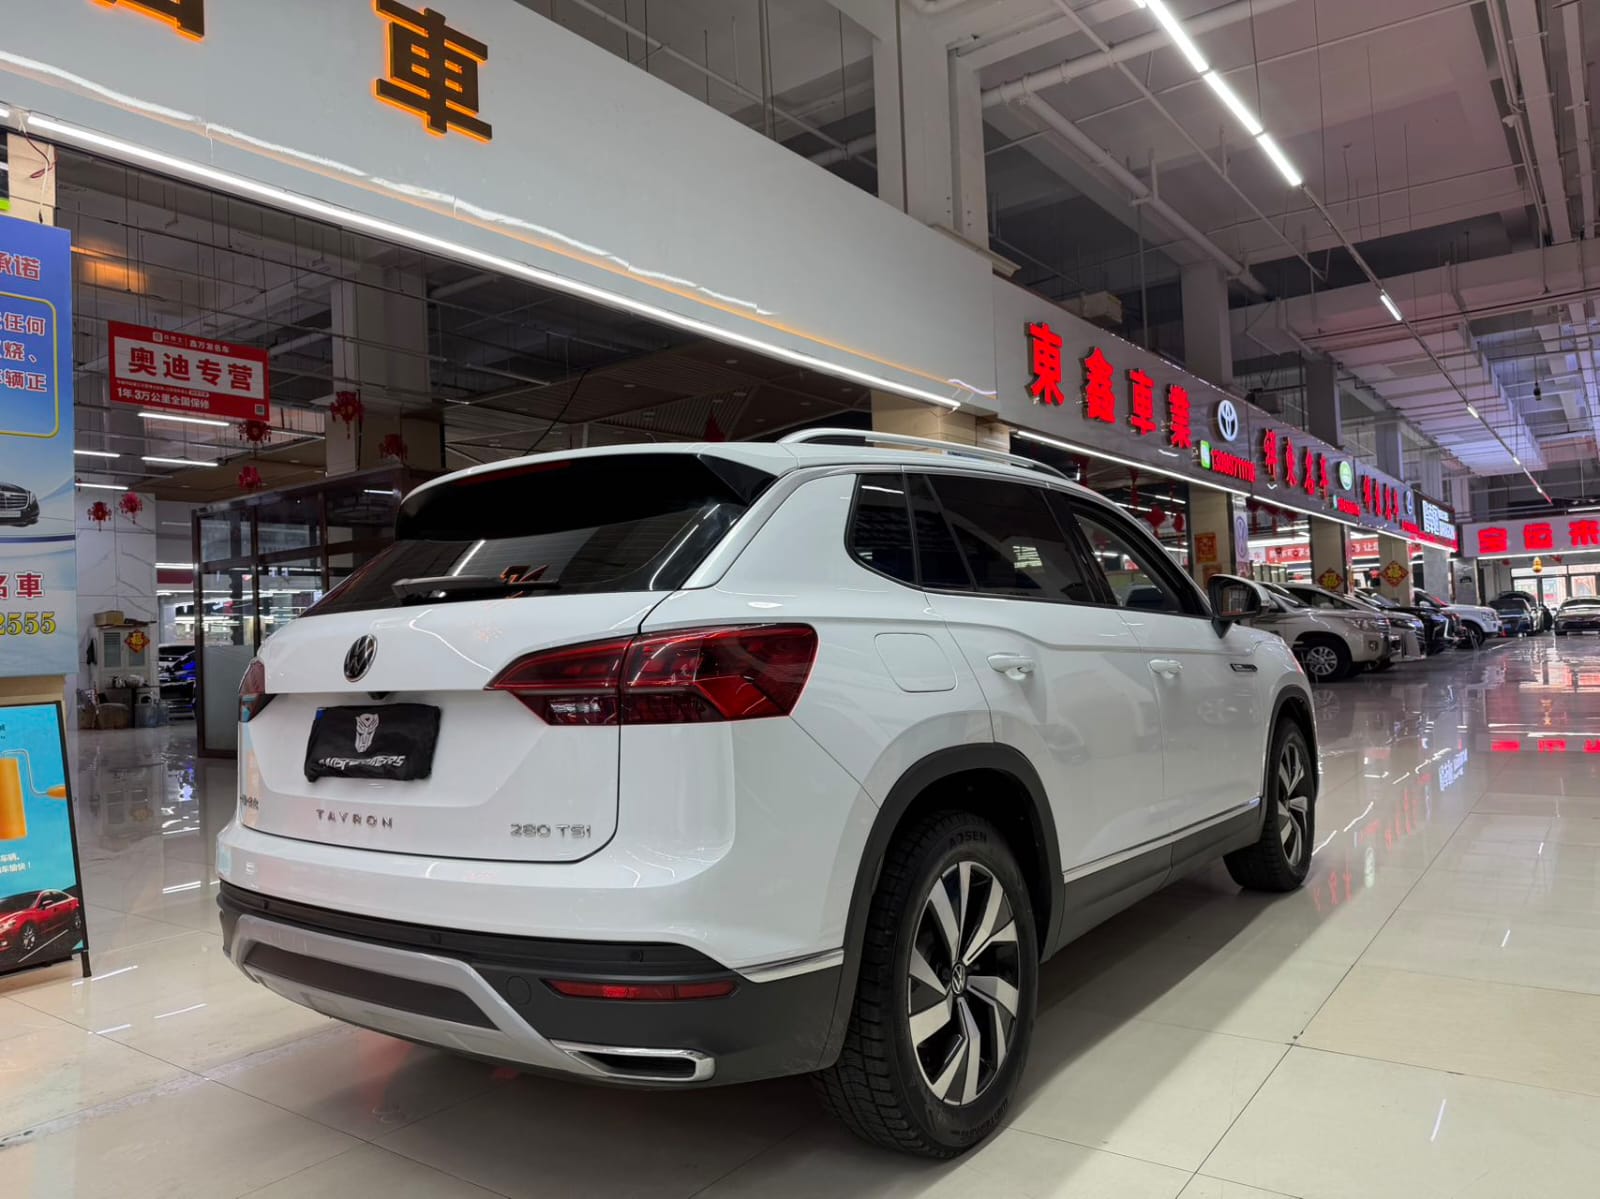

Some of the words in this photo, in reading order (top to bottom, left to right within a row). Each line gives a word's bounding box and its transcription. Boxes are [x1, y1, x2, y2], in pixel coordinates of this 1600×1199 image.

[0, 312, 46, 336] 任何
[0, 341, 37, 363] 烧、
[128, 346, 253, 392] 奥迪专营
[0, 370, 47, 392] 辆正
[510, 823, 552, 839] 280
